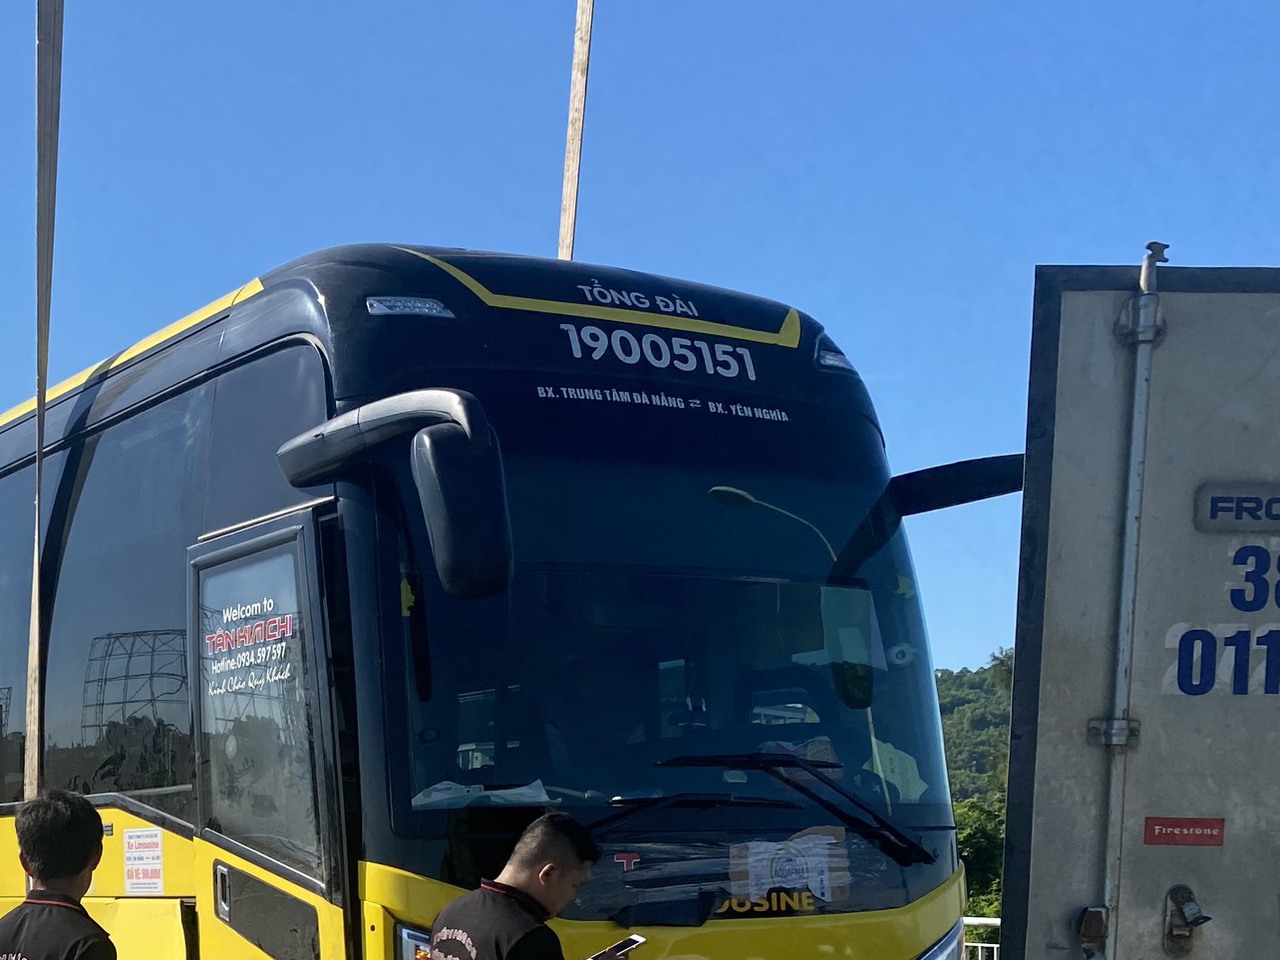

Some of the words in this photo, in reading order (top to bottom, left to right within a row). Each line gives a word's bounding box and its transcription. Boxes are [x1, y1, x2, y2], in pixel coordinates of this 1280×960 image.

[576, 278, 650, 308] TỔNG
[654, 293, 699, 317] ĐÀI
[560, 323, 756, 381] 19005151
[536, 386, 559, 398] BX.
[560, 387, 603, 401] TRUNG
[604, 388, 631, 402] TÂM
[708, 401, 728, 414] BX.
[729, 403, 753, 418] YÊN
[753, 407, 790, 422] NGHĨA
[1230, 545, 1280, 612] 3
[222, 601, 261, 624] Welcom
[263, 597, 274, 612] to
[206, 627, 235, 656] TÂN
[236, 621, 265, 648] KIM
[266, 614, 293, 641] CHI
[227, 675, 246, 692] Chào
[1153, 824, 1220, 836] Firestone
